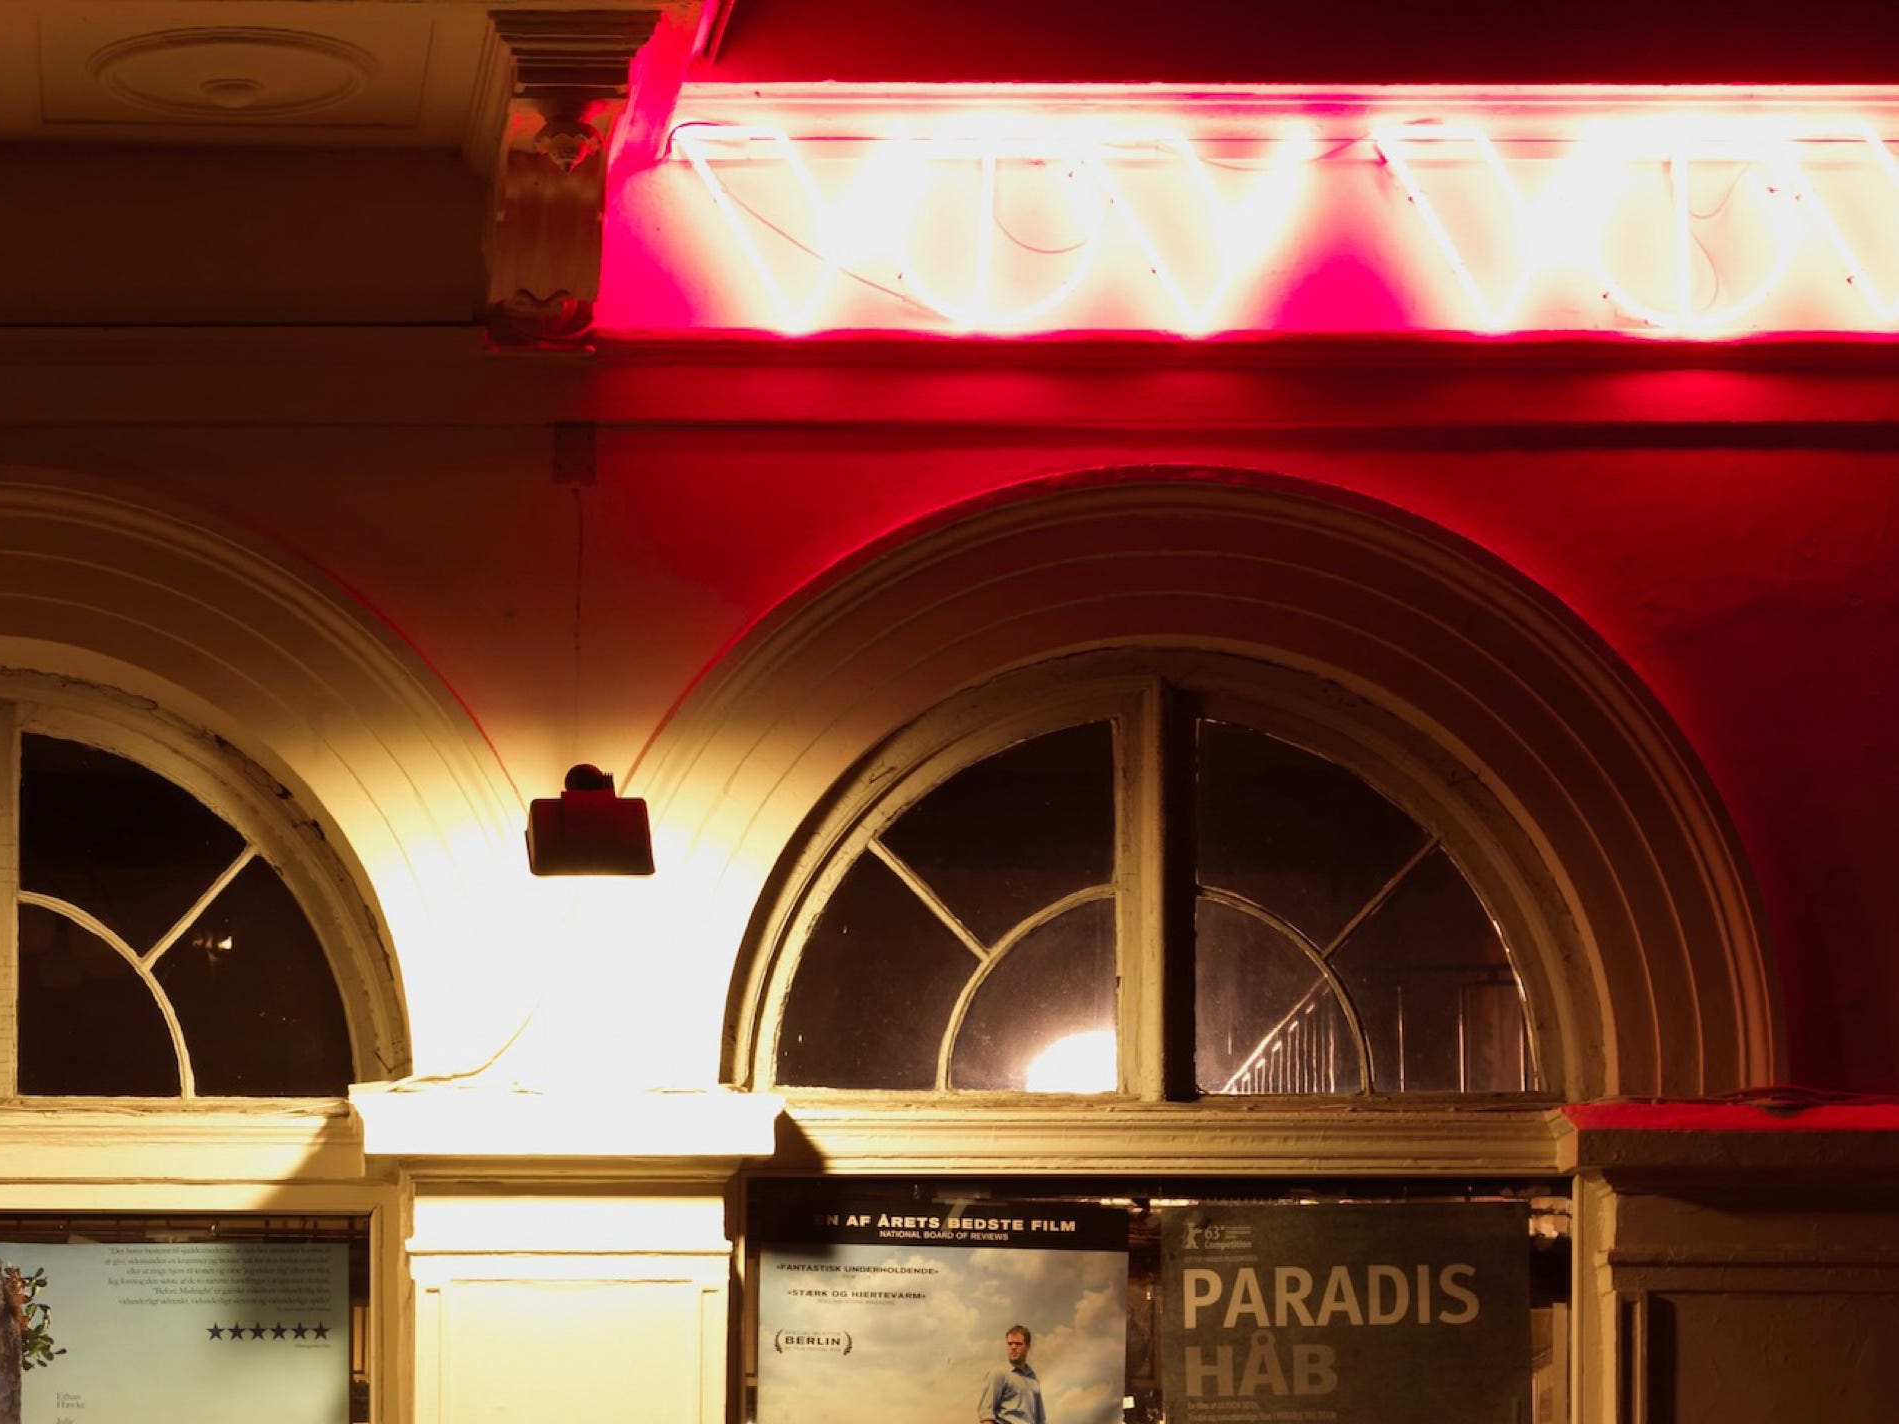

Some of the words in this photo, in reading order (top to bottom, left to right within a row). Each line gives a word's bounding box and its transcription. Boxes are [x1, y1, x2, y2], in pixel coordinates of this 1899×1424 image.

[845, 1215, 871, 1228] AF
[876, 1212, 940, 1230] ÅRETS
[947, 1217, 1024, 1232] BEDSTE
[1030, 1219, 1076, 1233] FILM
[879, 1230, 920, 1240] NATIONAL
[923, 1231, 952, 1241] BOARD
[955, 1231, 968, 1241] OF
[970, 1232, 1009, 1242] REVIEWS
[832, 1290, 848, 1298] OG
[1183, 1263, 1481, 1329] PARADIS
[784, 1335, 841, 1346] BERLIN
[1186, 1329, 1339, 1396] HÅB
